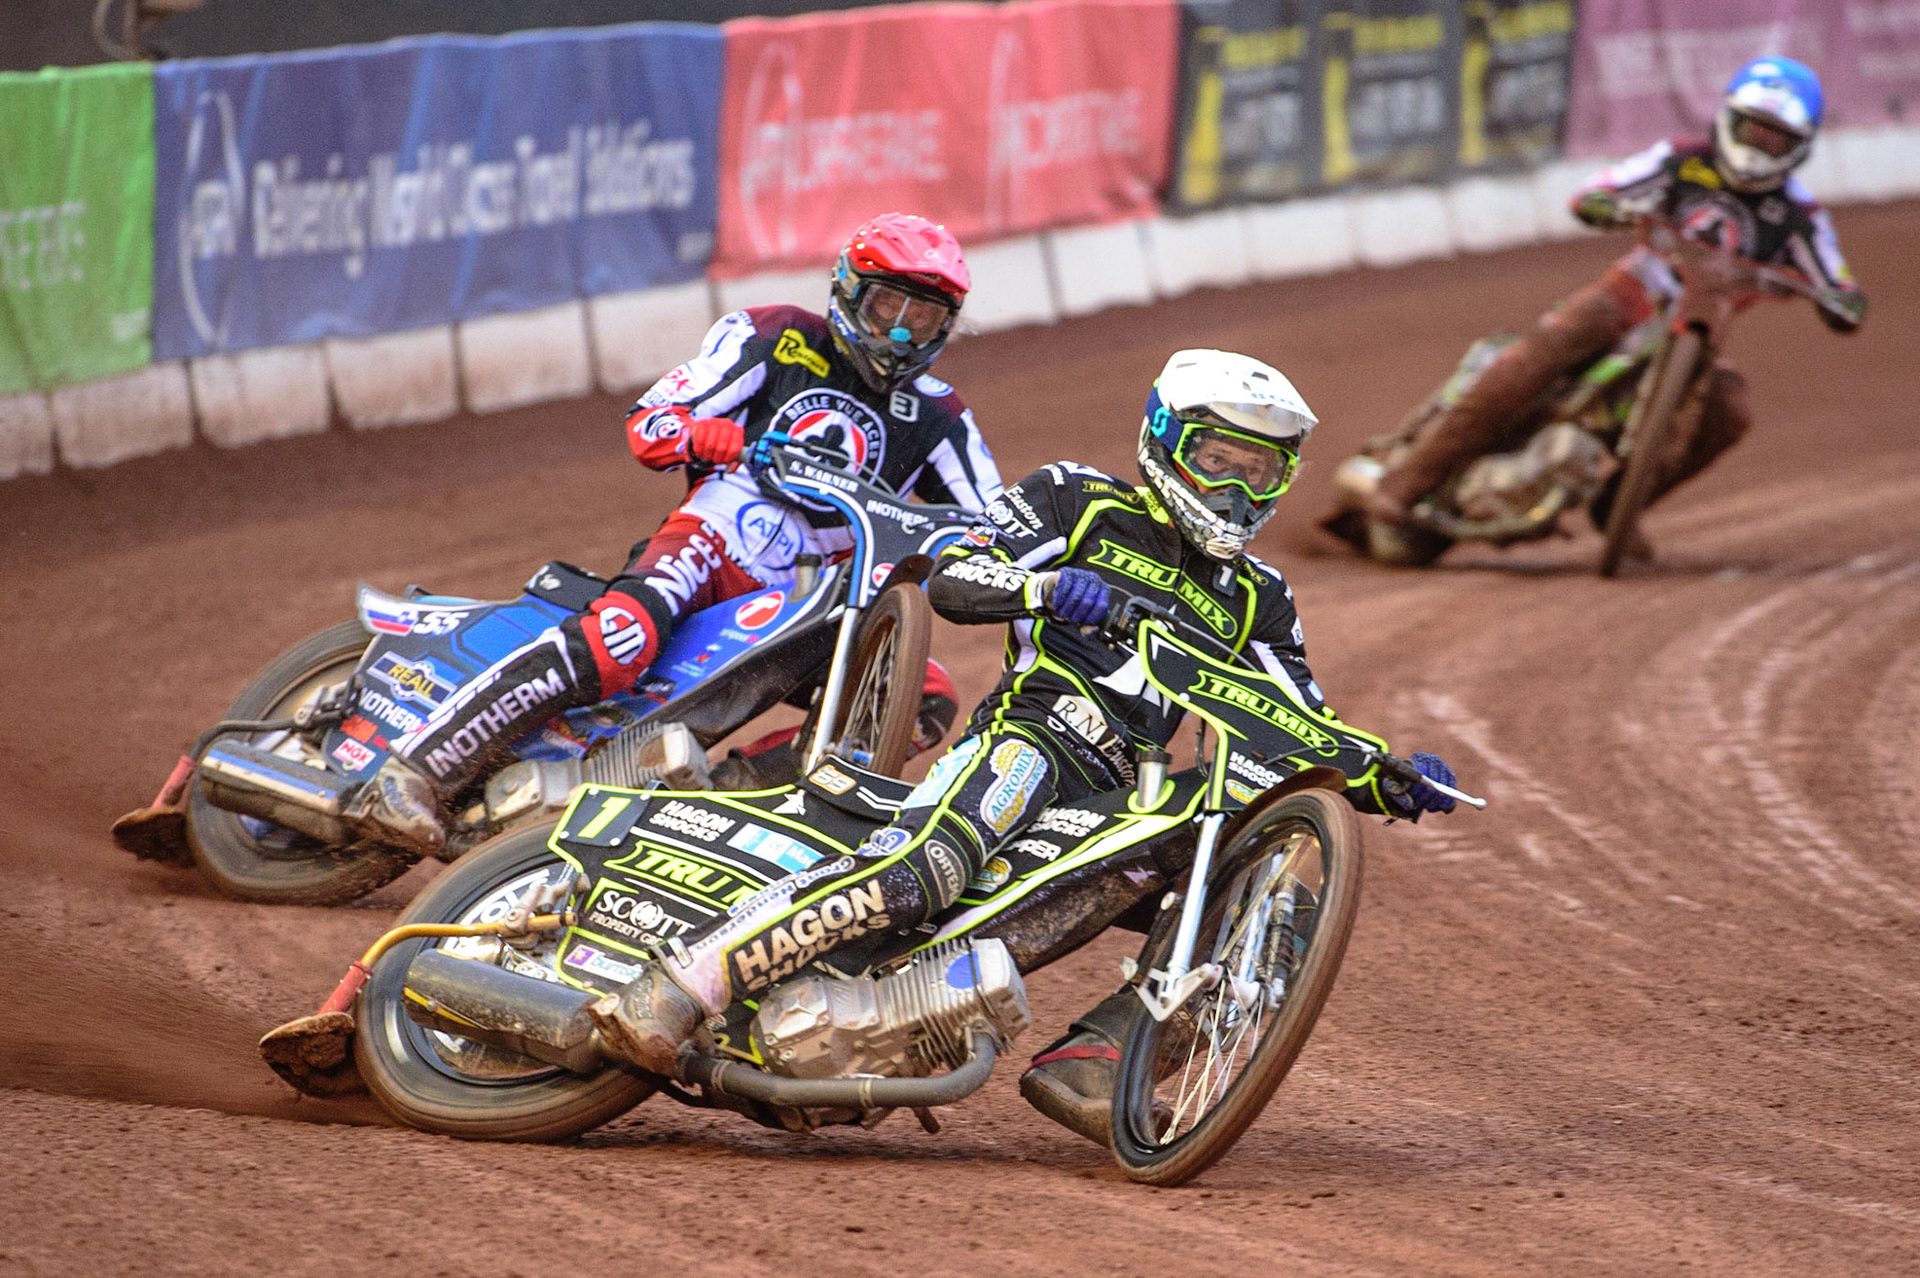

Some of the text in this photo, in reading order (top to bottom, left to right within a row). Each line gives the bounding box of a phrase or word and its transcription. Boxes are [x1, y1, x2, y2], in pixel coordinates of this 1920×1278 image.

[785, 396, 831, 421] BELLE
[836, 399, 864, 424] VUE
[942, 560, 1027, 592] SHOCKS
[1109, 548, 1231, 632] TRU MIX
[1218, 565, 1234, 588] 1
[359, 685, 425, 735] NOTHER
[424, 666, 567, 779] INOTHERM
[1209, 678, 1330, 749] TRU MIX
[990, 747, 1035, 820] AGROMIX
[1227, 761, 1277, 790] SHOC
[577, 796, 632, 840] 1
[648, 813, 722, 844] SHOCKS
[659, 800, 737, 834] HAGON
[634, 849, 734, 894] TRU
[588, 910, 643, 939] PROPERTY
[595, 890, 697, 938] SCOTT
[735, 878, 887, 984] HAGON
[746, 913, 891, 992] SHOCKS
